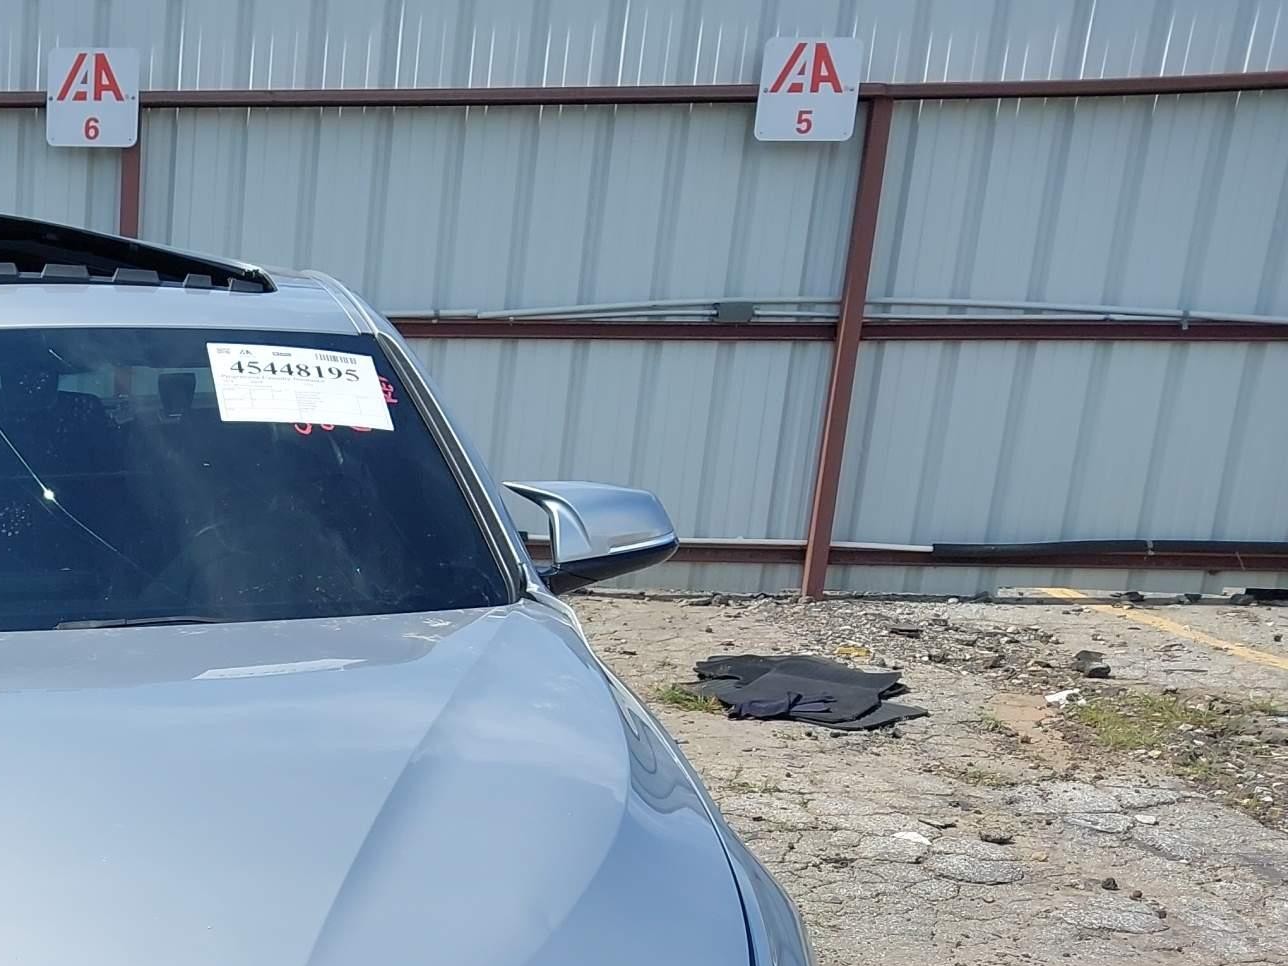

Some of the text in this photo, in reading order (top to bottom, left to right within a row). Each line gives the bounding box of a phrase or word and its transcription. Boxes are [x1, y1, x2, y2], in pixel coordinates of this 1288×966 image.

[84, 117, 100, 141] 6
[795, 110, 813, 135] 5
[230, 360, 360, 382] 45448195
